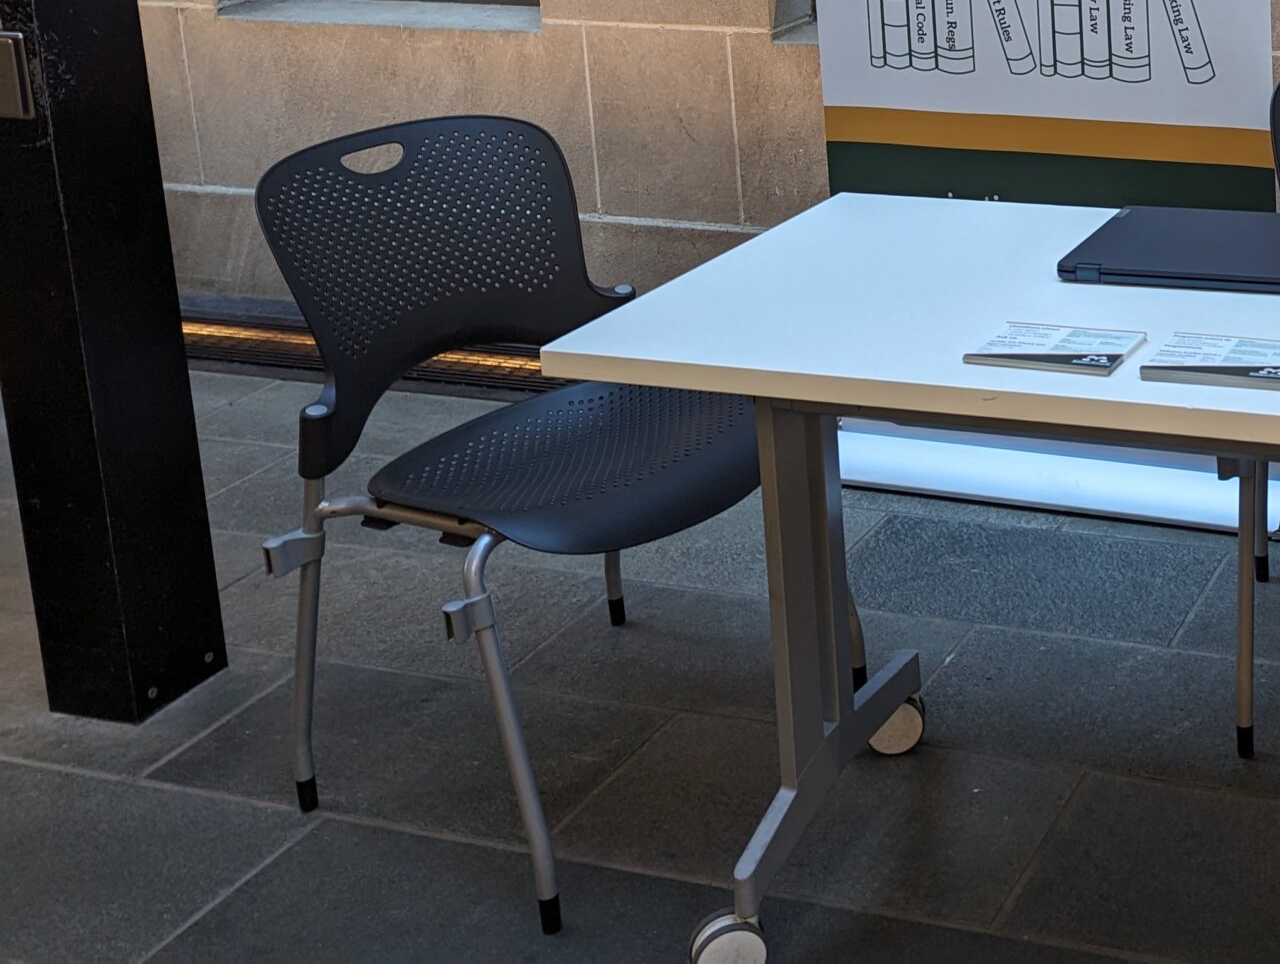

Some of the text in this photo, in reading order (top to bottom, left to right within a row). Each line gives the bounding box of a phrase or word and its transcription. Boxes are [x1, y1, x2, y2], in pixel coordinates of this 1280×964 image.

[916, 12, 927, 44] Code
[995, 7, 1012, 43] Rules
[1089, 7, 1100, 35] Law
[1124, 25, 1135, 54] Law
[1178, 26, 1193, 55] Law
